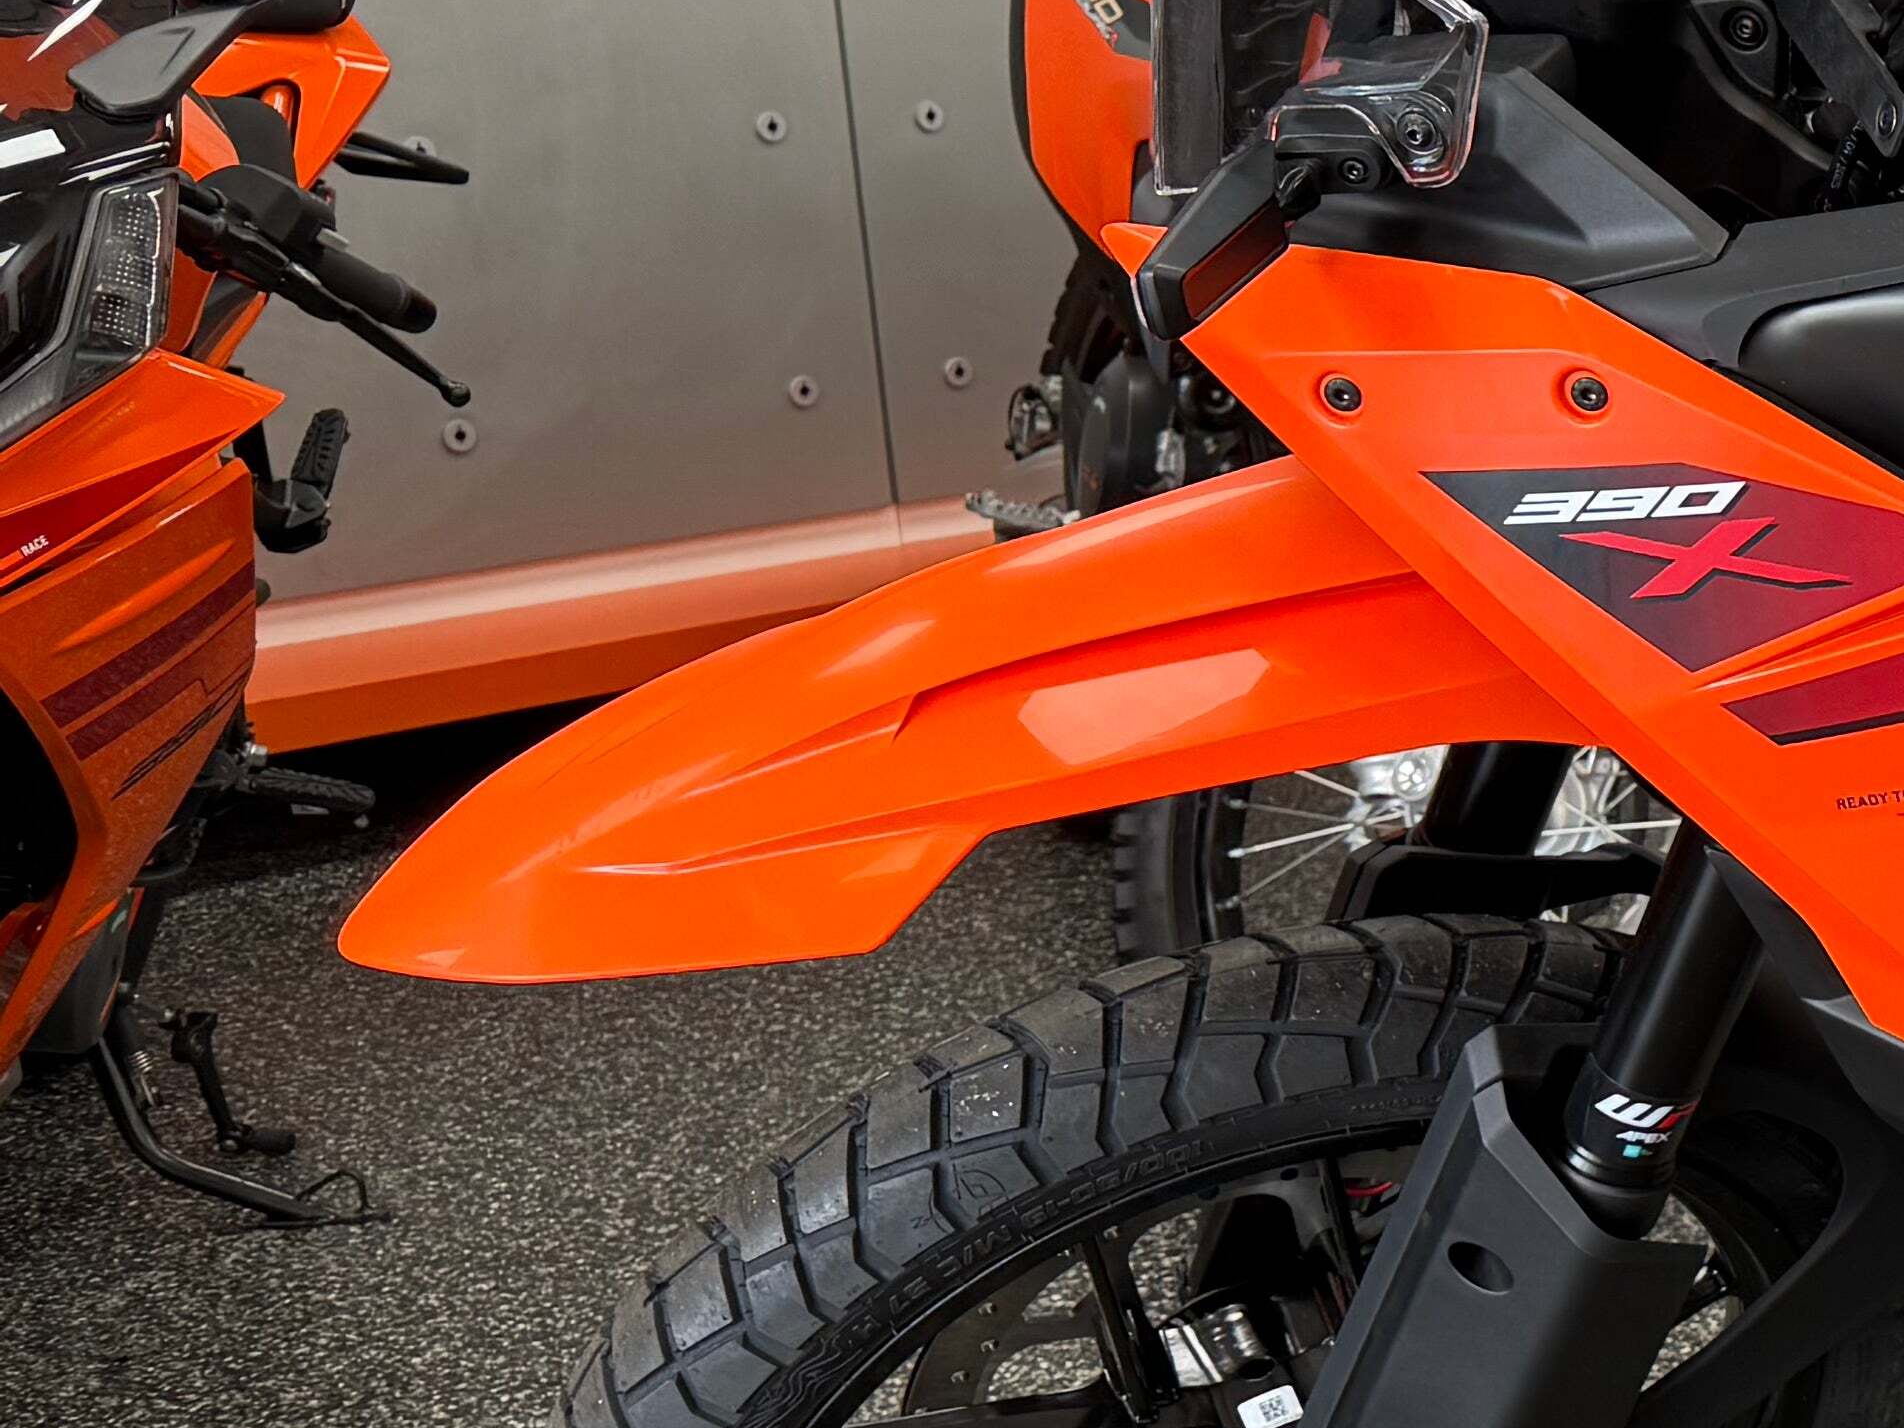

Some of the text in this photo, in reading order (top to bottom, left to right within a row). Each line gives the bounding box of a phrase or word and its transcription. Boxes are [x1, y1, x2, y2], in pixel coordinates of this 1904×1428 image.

[1503, 480, 1747, 525] 390
[1557, 516, 1854, 600] X
[1836, 792, 1889, 811] READY
